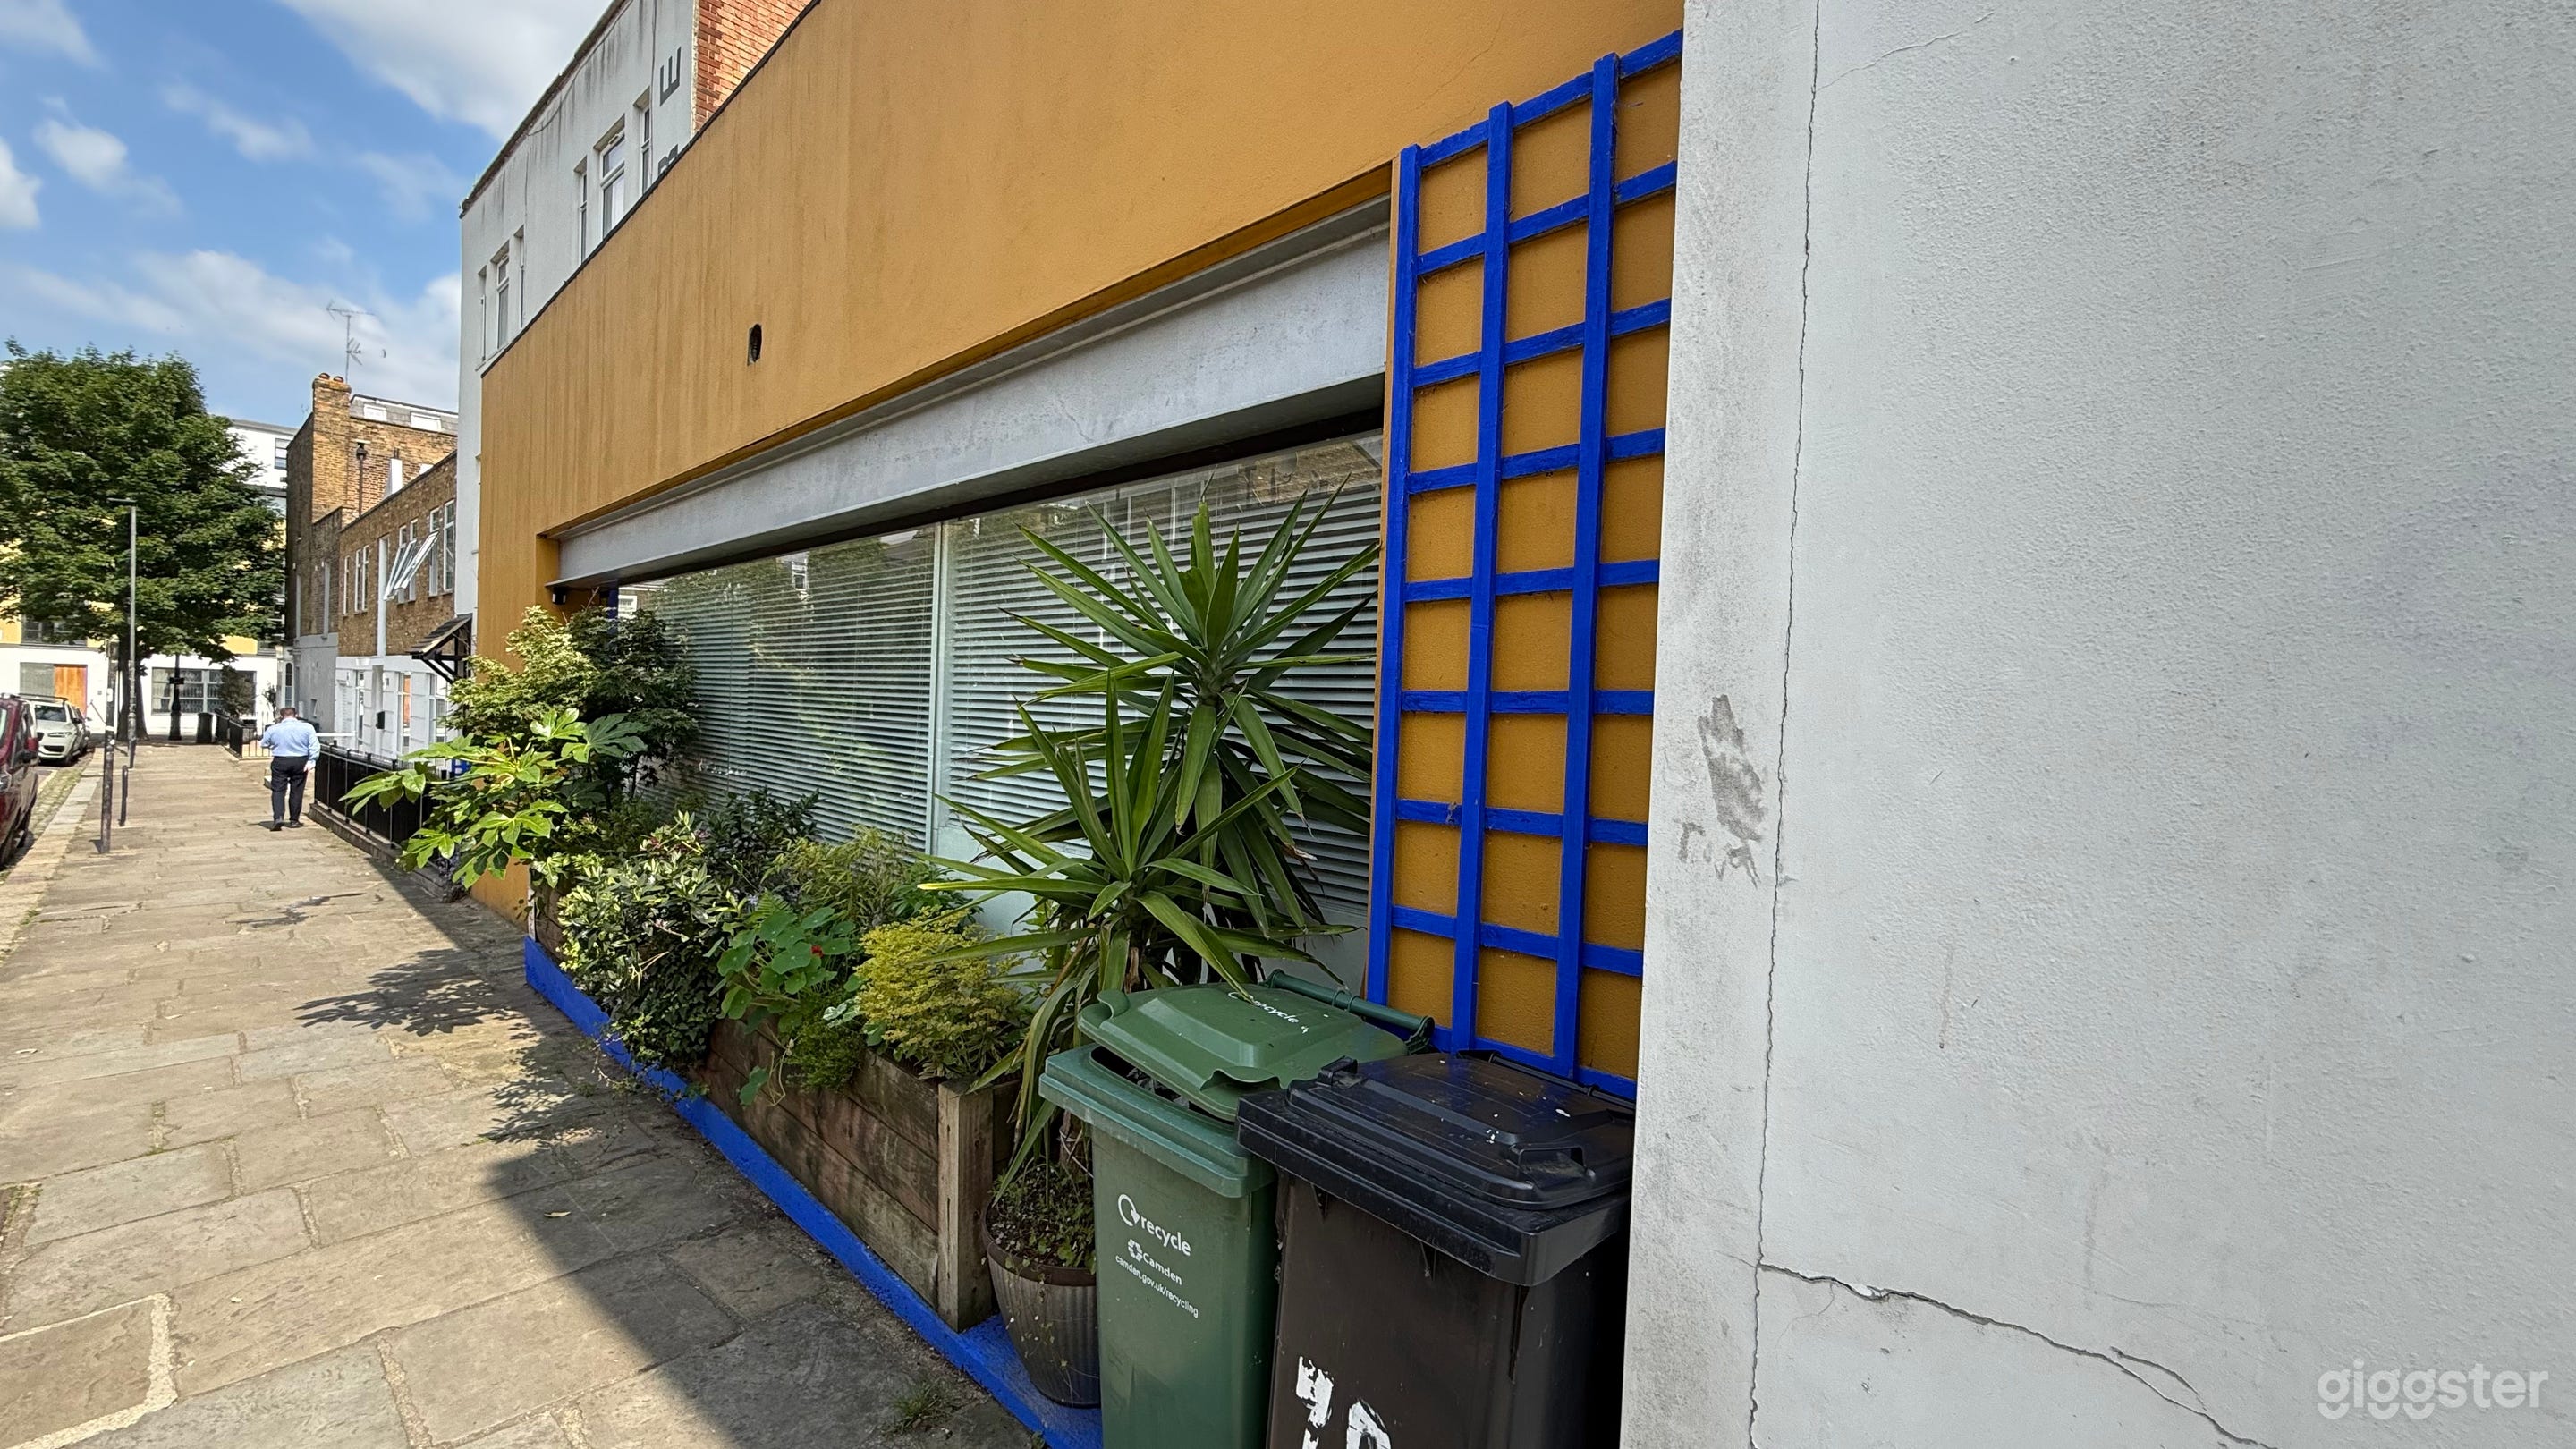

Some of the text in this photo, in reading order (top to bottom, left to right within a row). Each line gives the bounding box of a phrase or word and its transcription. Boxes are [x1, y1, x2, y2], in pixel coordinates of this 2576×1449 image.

[1140, 1216, 1191, 1256] recycle
[1115, 1255, 1199, 1318] camden.gov.uk/recycling
[1142, 1252, 1182, 1285] Camden
